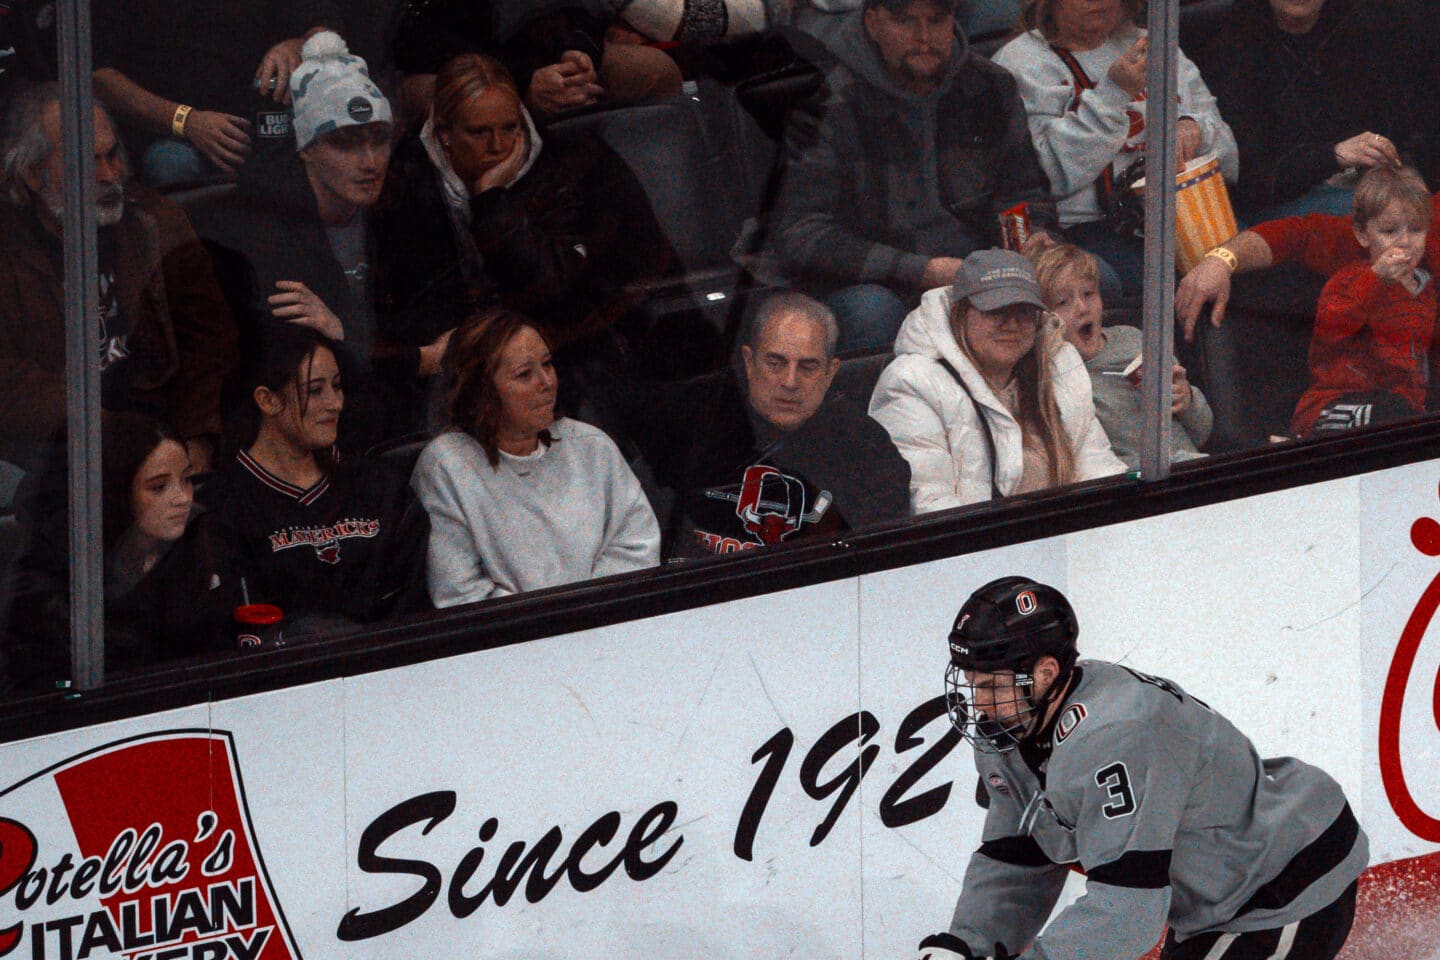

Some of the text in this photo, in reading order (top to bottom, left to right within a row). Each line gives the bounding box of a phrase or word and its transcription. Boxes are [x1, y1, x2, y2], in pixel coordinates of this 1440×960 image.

[268, 519, 380, 553] MAVERICKS
[337, 693, 990, 942] Since 192
[1094, 761, 1137, 820] 3
